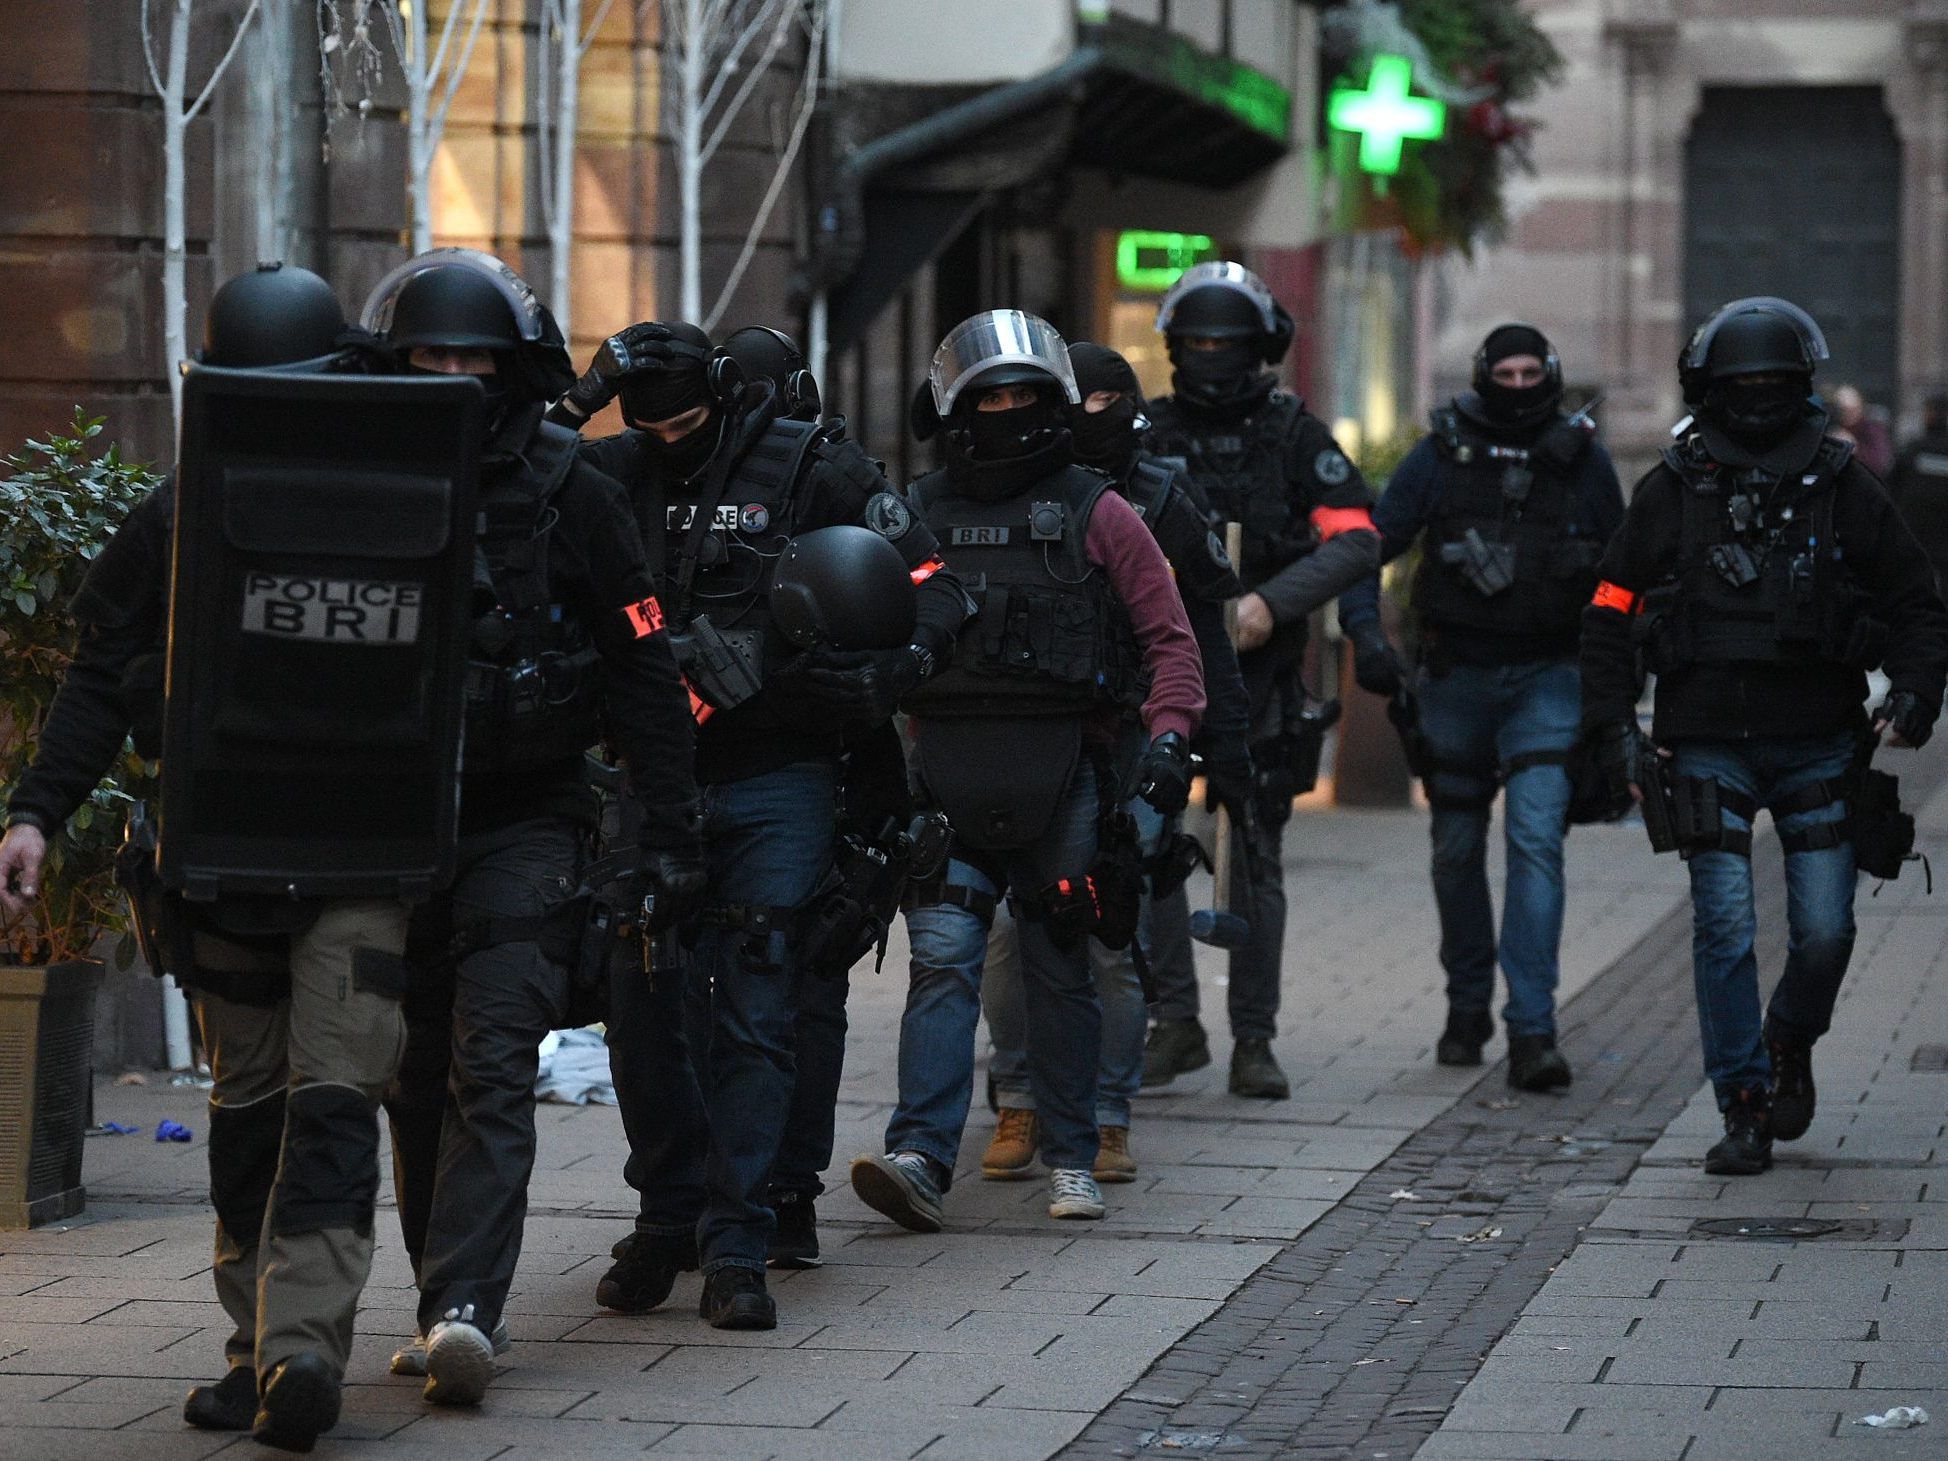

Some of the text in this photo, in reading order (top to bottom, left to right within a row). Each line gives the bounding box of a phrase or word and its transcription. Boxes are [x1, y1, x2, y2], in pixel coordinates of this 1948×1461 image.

[960, 527, 1001, 543] BRI
[248, 576, 419, 607] POLICE
[264, 599, 400, 640] BRI
